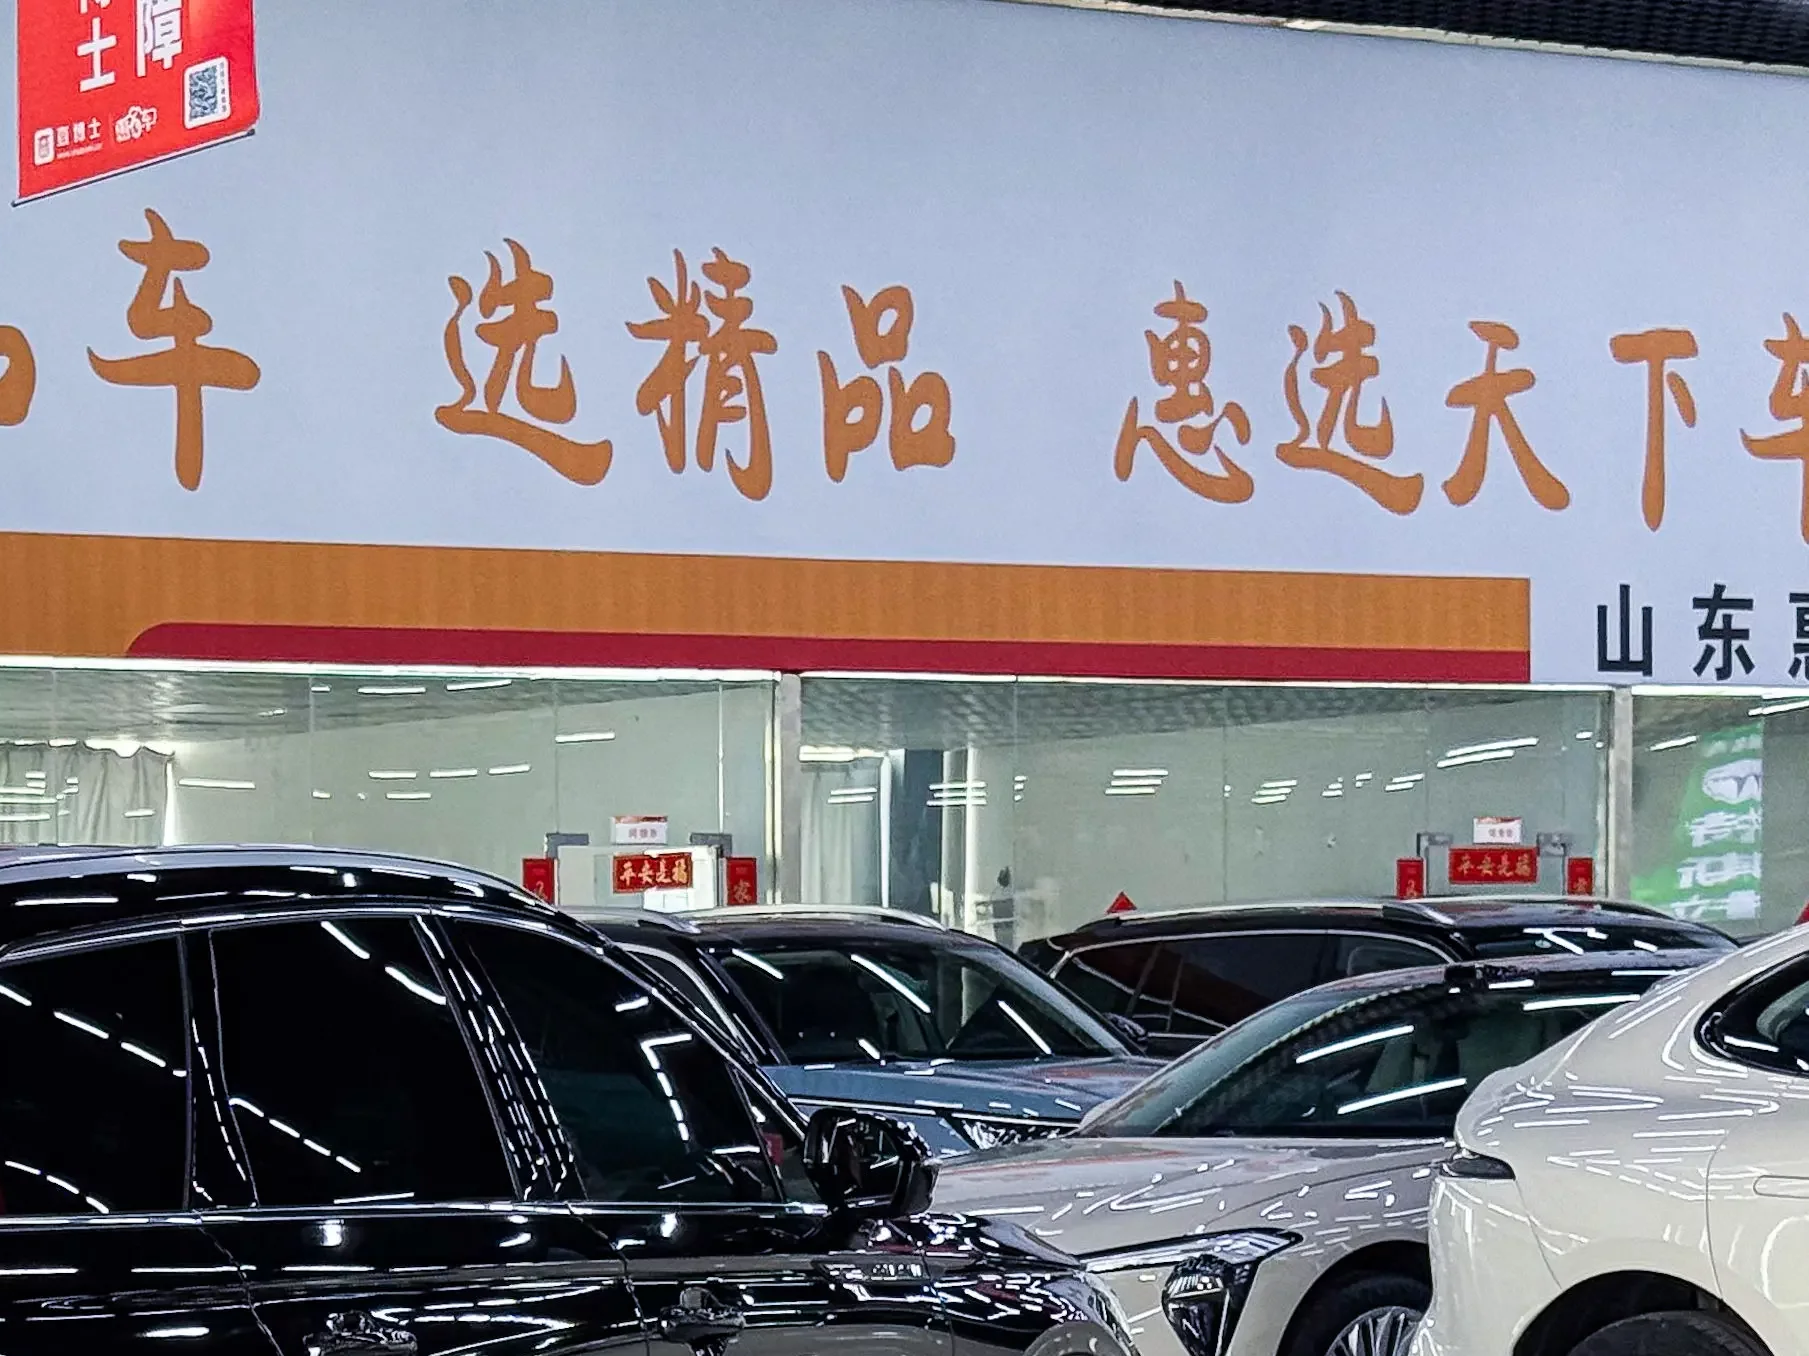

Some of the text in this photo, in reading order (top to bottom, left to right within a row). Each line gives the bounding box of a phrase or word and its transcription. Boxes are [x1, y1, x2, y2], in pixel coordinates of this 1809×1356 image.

[77, 0, 117, 93] 士
[434, 238, 956, 501] 选精品
[1113, 279, 1809, 545] 惠选天下车
